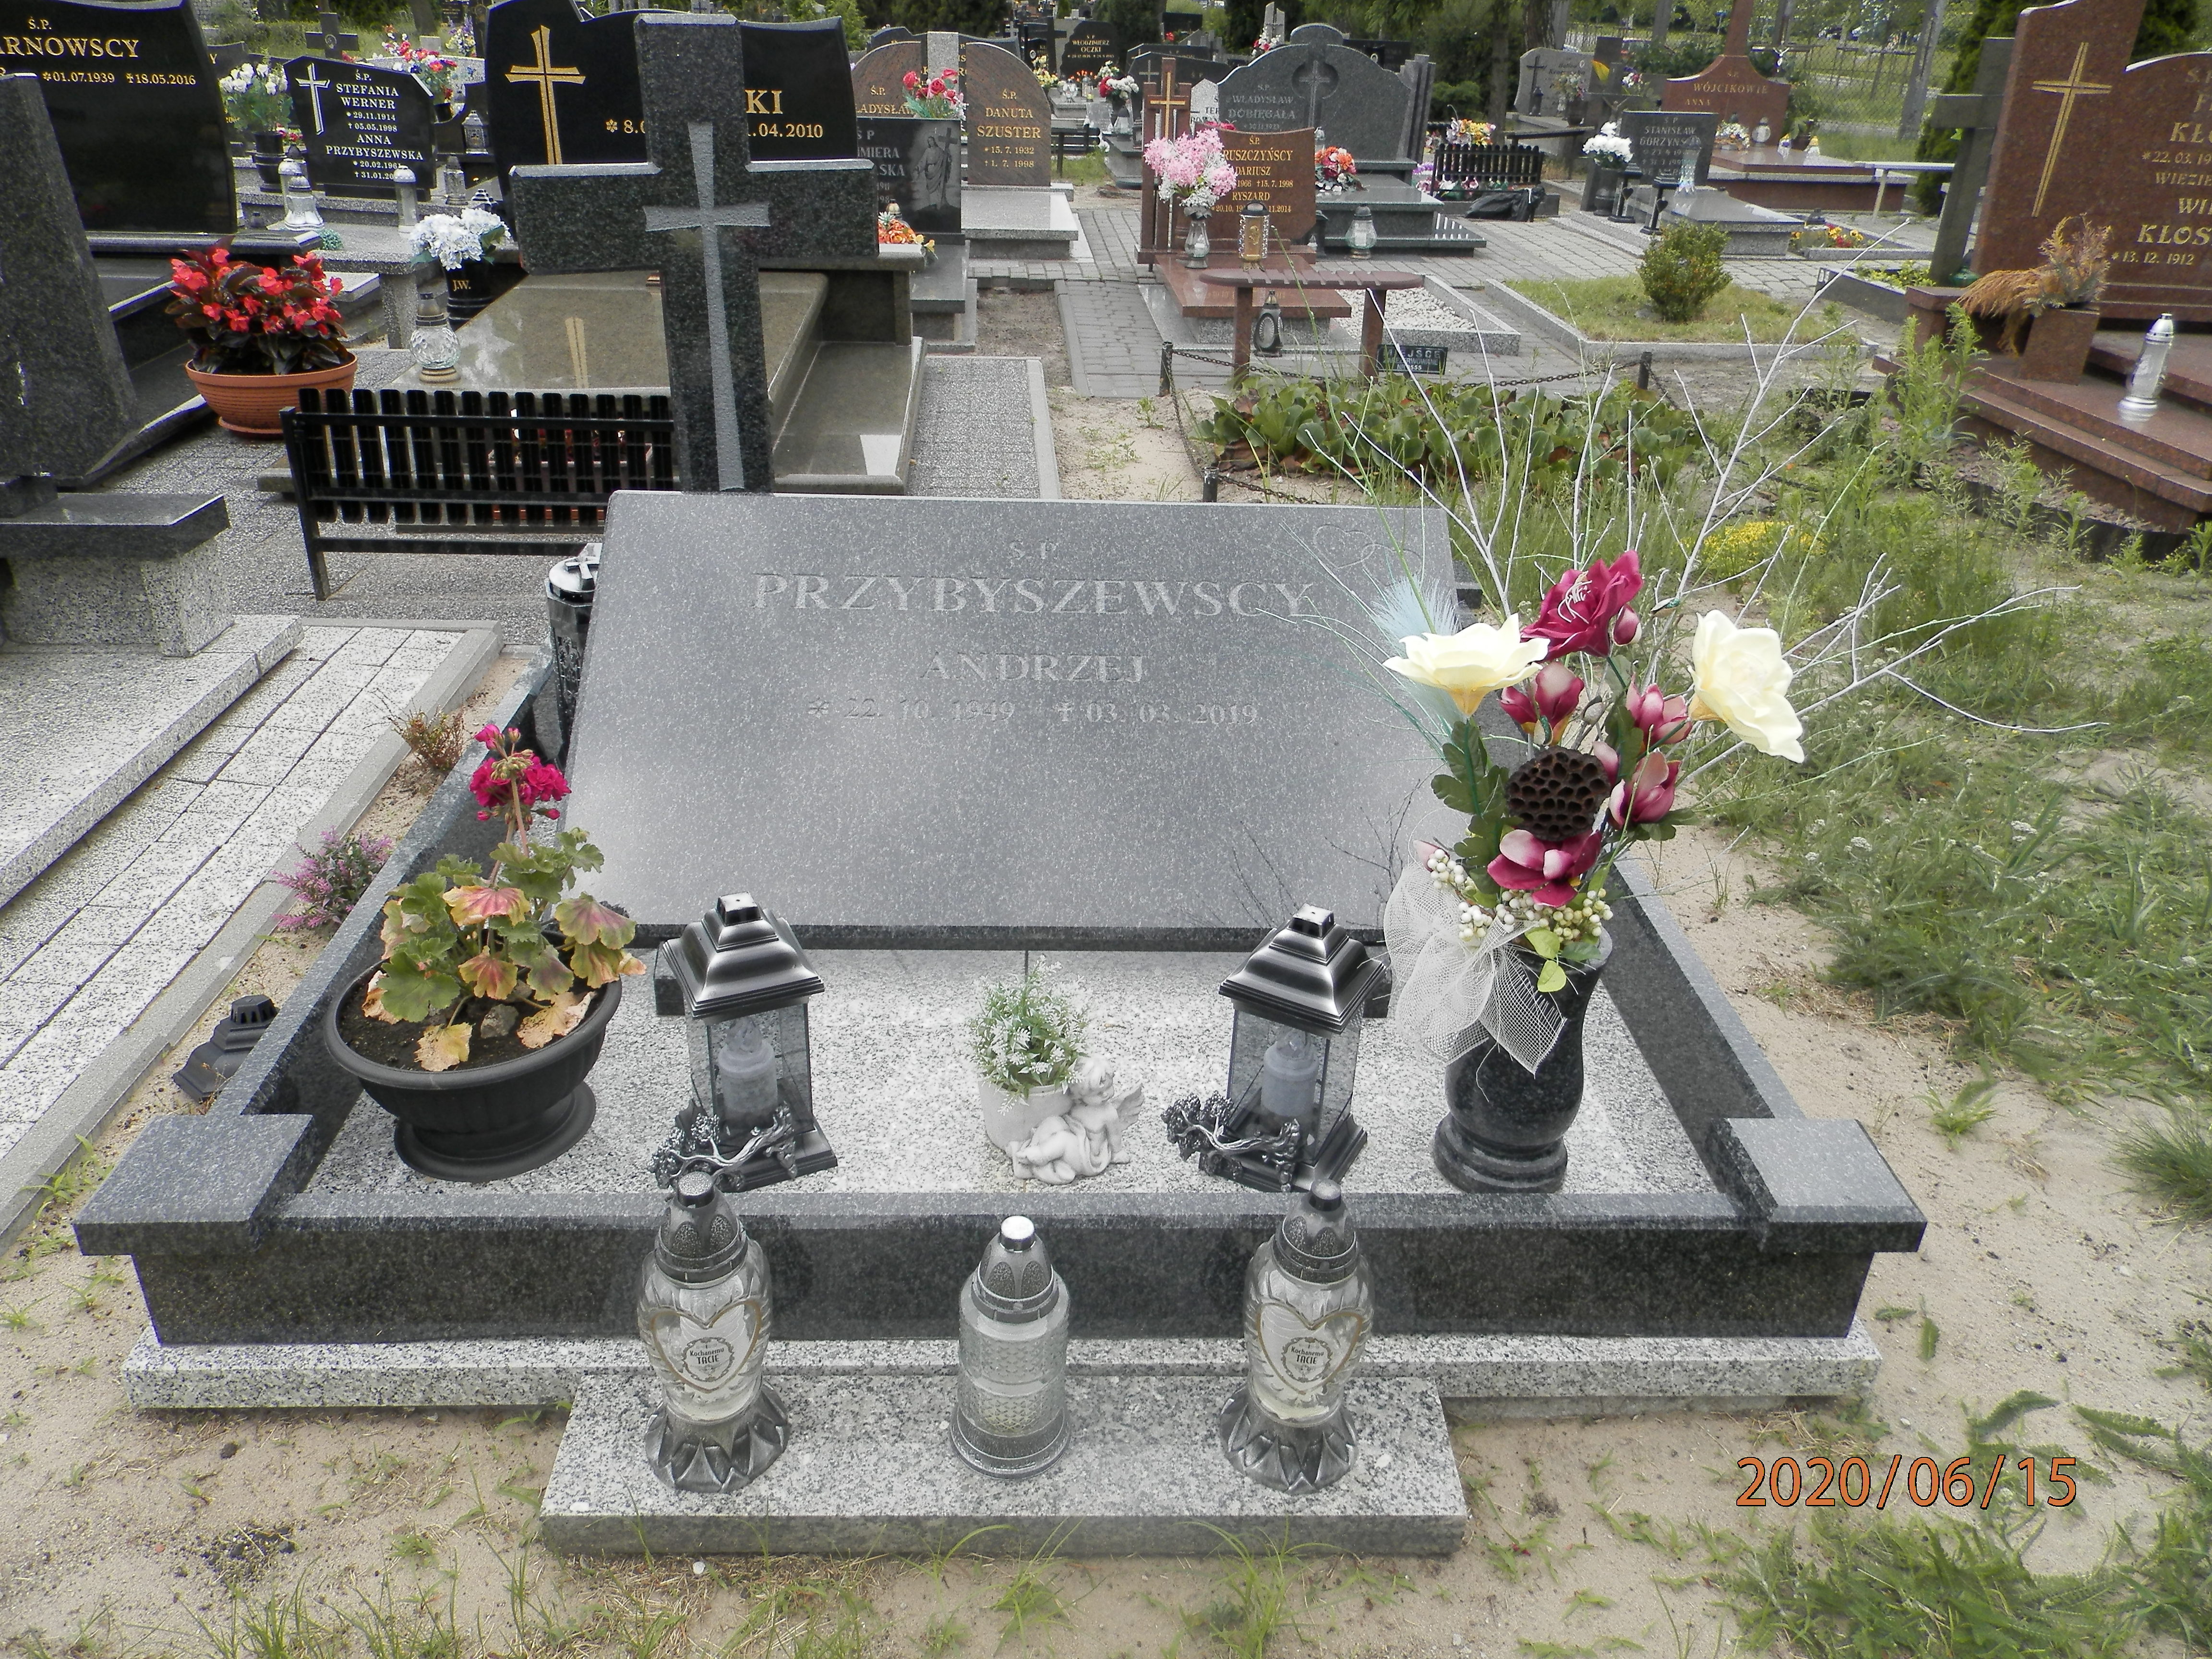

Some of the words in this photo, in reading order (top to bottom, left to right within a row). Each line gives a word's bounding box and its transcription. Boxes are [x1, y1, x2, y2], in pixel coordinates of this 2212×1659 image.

[0, 36, 139, 58] RNOWSCY
[336, 83, 399, 96] STEFANIA
[1693, 81, 1768, 94] WÓJCIKOWIE
[341, 96, 396, 109] WERNER
[353, 111, 396, 121] 29.11.1914
[986, 107, 1034, 118] DANUTA
[976, 125, 1041, 139] SZUSTER
[1644, 126, 1697, 135] STANISŁAW
[357, 134, 392, 144] ANNA
[325, 145, 423, 160] PRZYBYSZEWSKA
[1235, 166, 1271, 176] DARIUSZ
[1232, 192, 1271, 201] RYSZARD
[2166, 253, 2195, 265] 1912
[749, 573, 1314, 616] PRZYBYSZEWSCY
[919, 651, 1147, 683] ANDRZEJ
[689, 1347, 724, 1357] Kochanemu
[1291, 1346, 1324, 1357] Kochanemu
[697, 1354, 720, 1365] TACIE
[1296, 1354, 1317, 1365] TACIE
